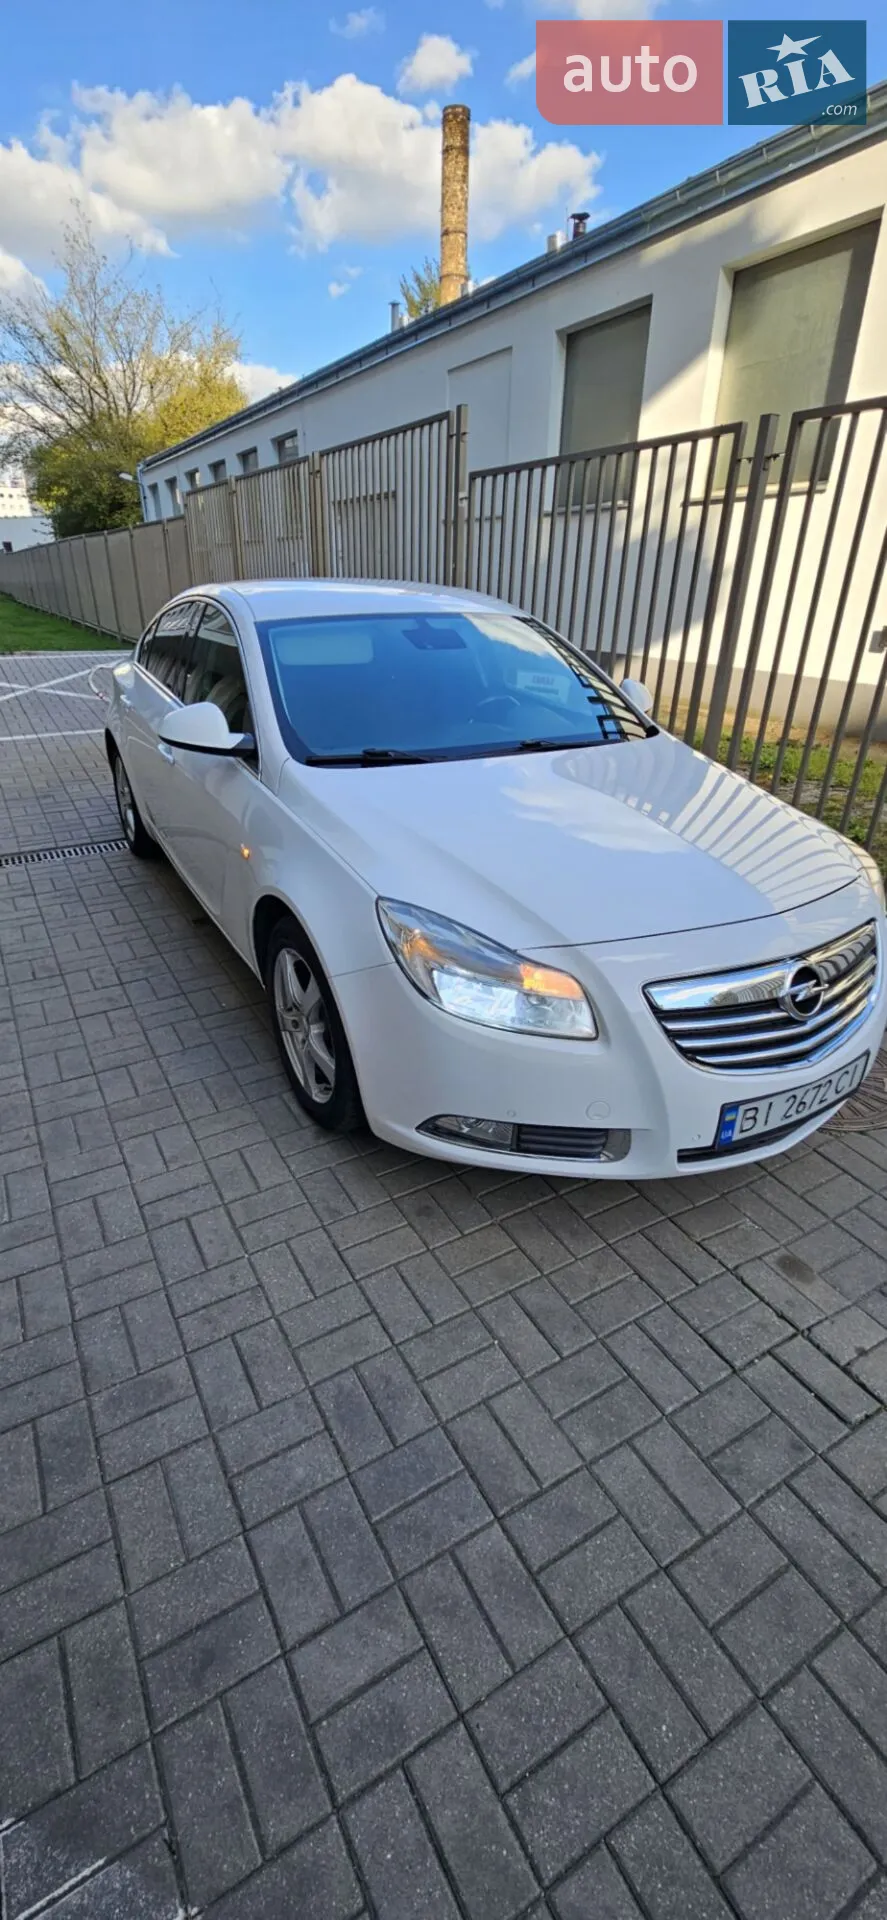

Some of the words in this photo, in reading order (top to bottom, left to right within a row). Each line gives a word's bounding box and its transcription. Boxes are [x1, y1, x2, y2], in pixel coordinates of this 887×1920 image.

[739, 1102, 773, 1134] BI
[781, 1079, 832, 1120] 2672
[834, 1063, 858, 1094] CI
[720, 1129, 732, 1140] UA
